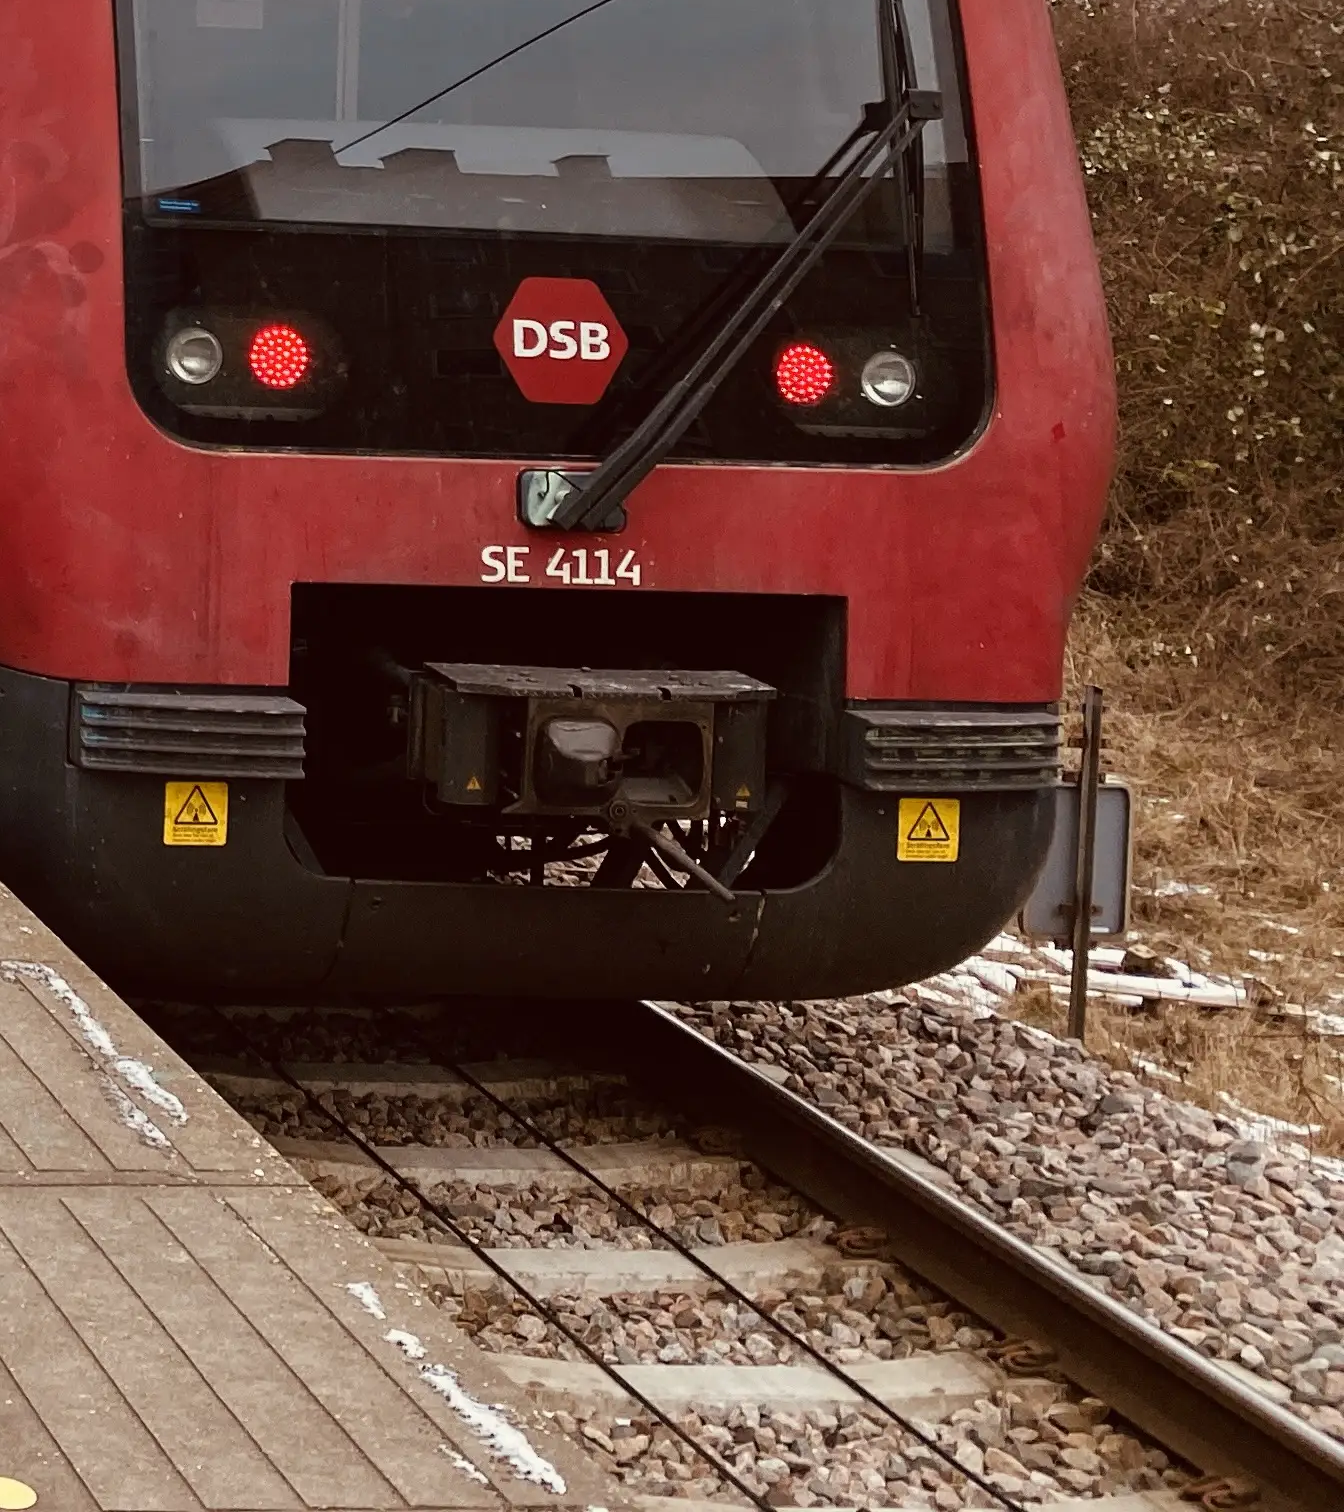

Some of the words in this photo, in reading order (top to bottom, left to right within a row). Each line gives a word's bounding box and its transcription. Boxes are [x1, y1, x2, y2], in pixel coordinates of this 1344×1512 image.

[512, 318, 611, 361] DSB
[481, 545, 530, 584] SE
[545, 547, 641, 586] 4114
